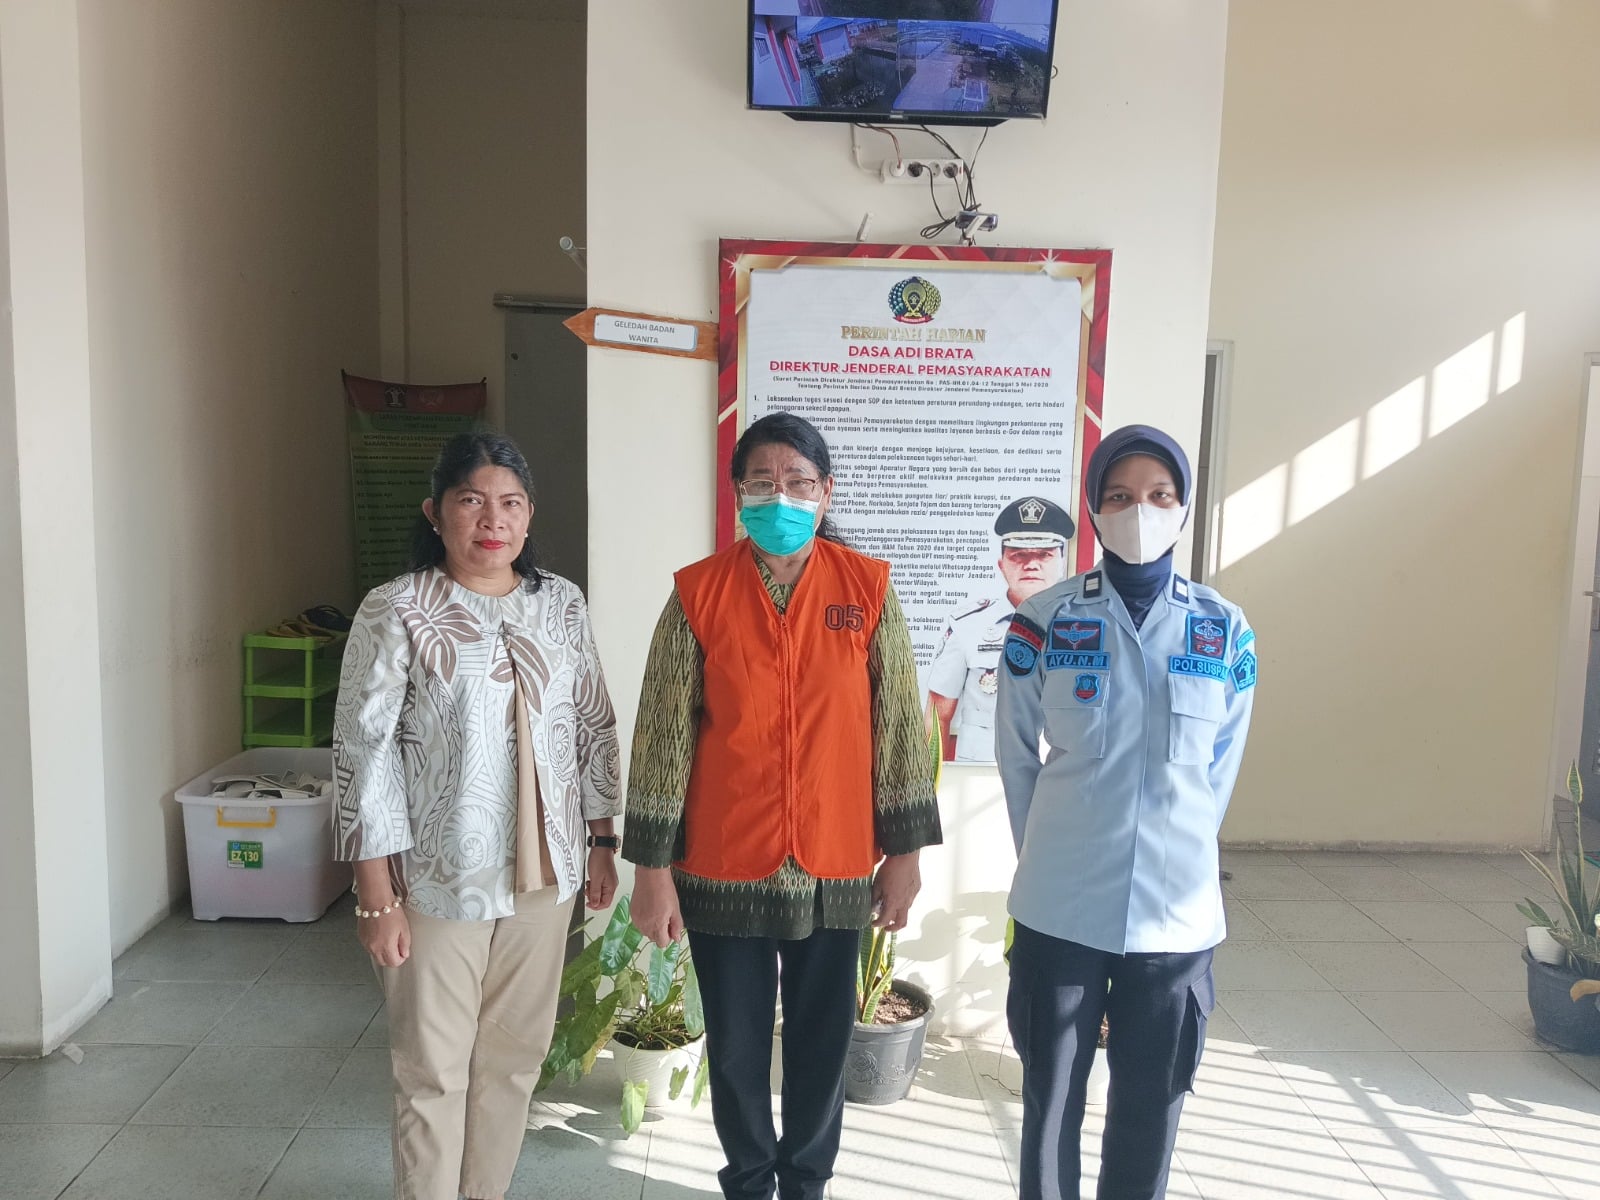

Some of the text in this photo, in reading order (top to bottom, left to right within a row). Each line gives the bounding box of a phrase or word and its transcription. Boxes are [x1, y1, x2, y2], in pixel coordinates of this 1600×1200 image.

[614, 320, 675, 334] GELEDAH BADAN
[841, 325, 986, 343] PERINTAH HARIAN
[628, 334, 659, 344] WANITA
[848, 345, 974, 359] DASA ADI BRATA
[770, 361, 1051, 377] DIREKTUR JENDERAL PEMASYARAKATAN
[824, 605, 865, 632] 05
[1048, 653, 1105, 669] AYU.N.M
[1174, 659, 1228, 681] POLSUSPA
[231, 850, 259, 862] EZ 130
